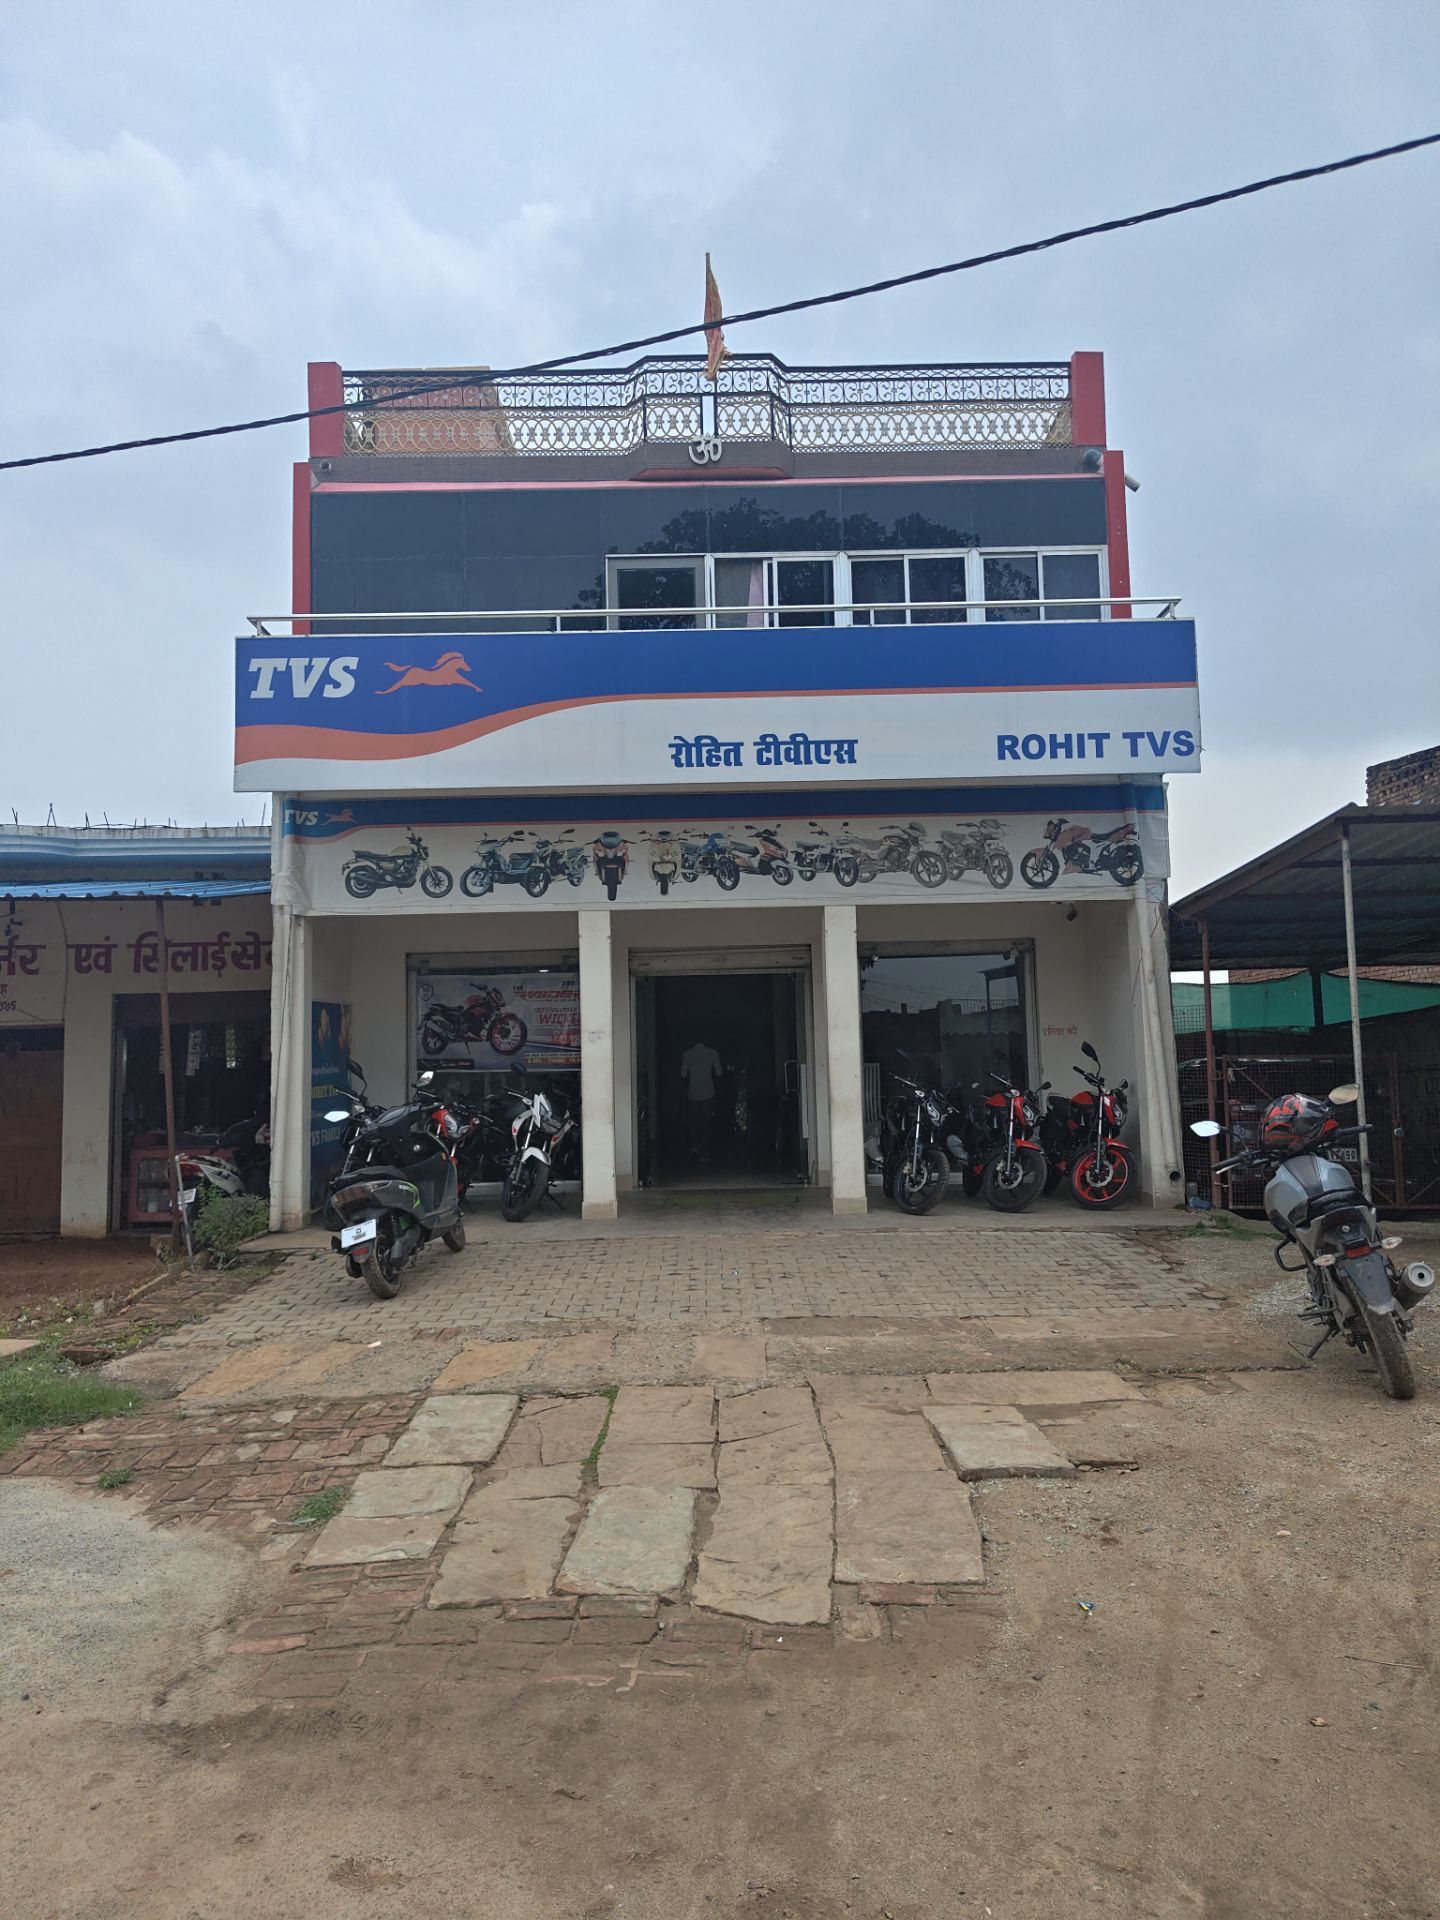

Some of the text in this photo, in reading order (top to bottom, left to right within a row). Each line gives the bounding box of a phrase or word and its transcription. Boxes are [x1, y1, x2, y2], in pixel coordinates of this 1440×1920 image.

[248, 656, 359, 699] TVS
[668, 732, 859, 768] रोहित टीवीएस
[997, 730, 1195, 760] ROHIT TVS
[284, 809, 320, 826] TVS
[66, 935, 118, 974] एवं
